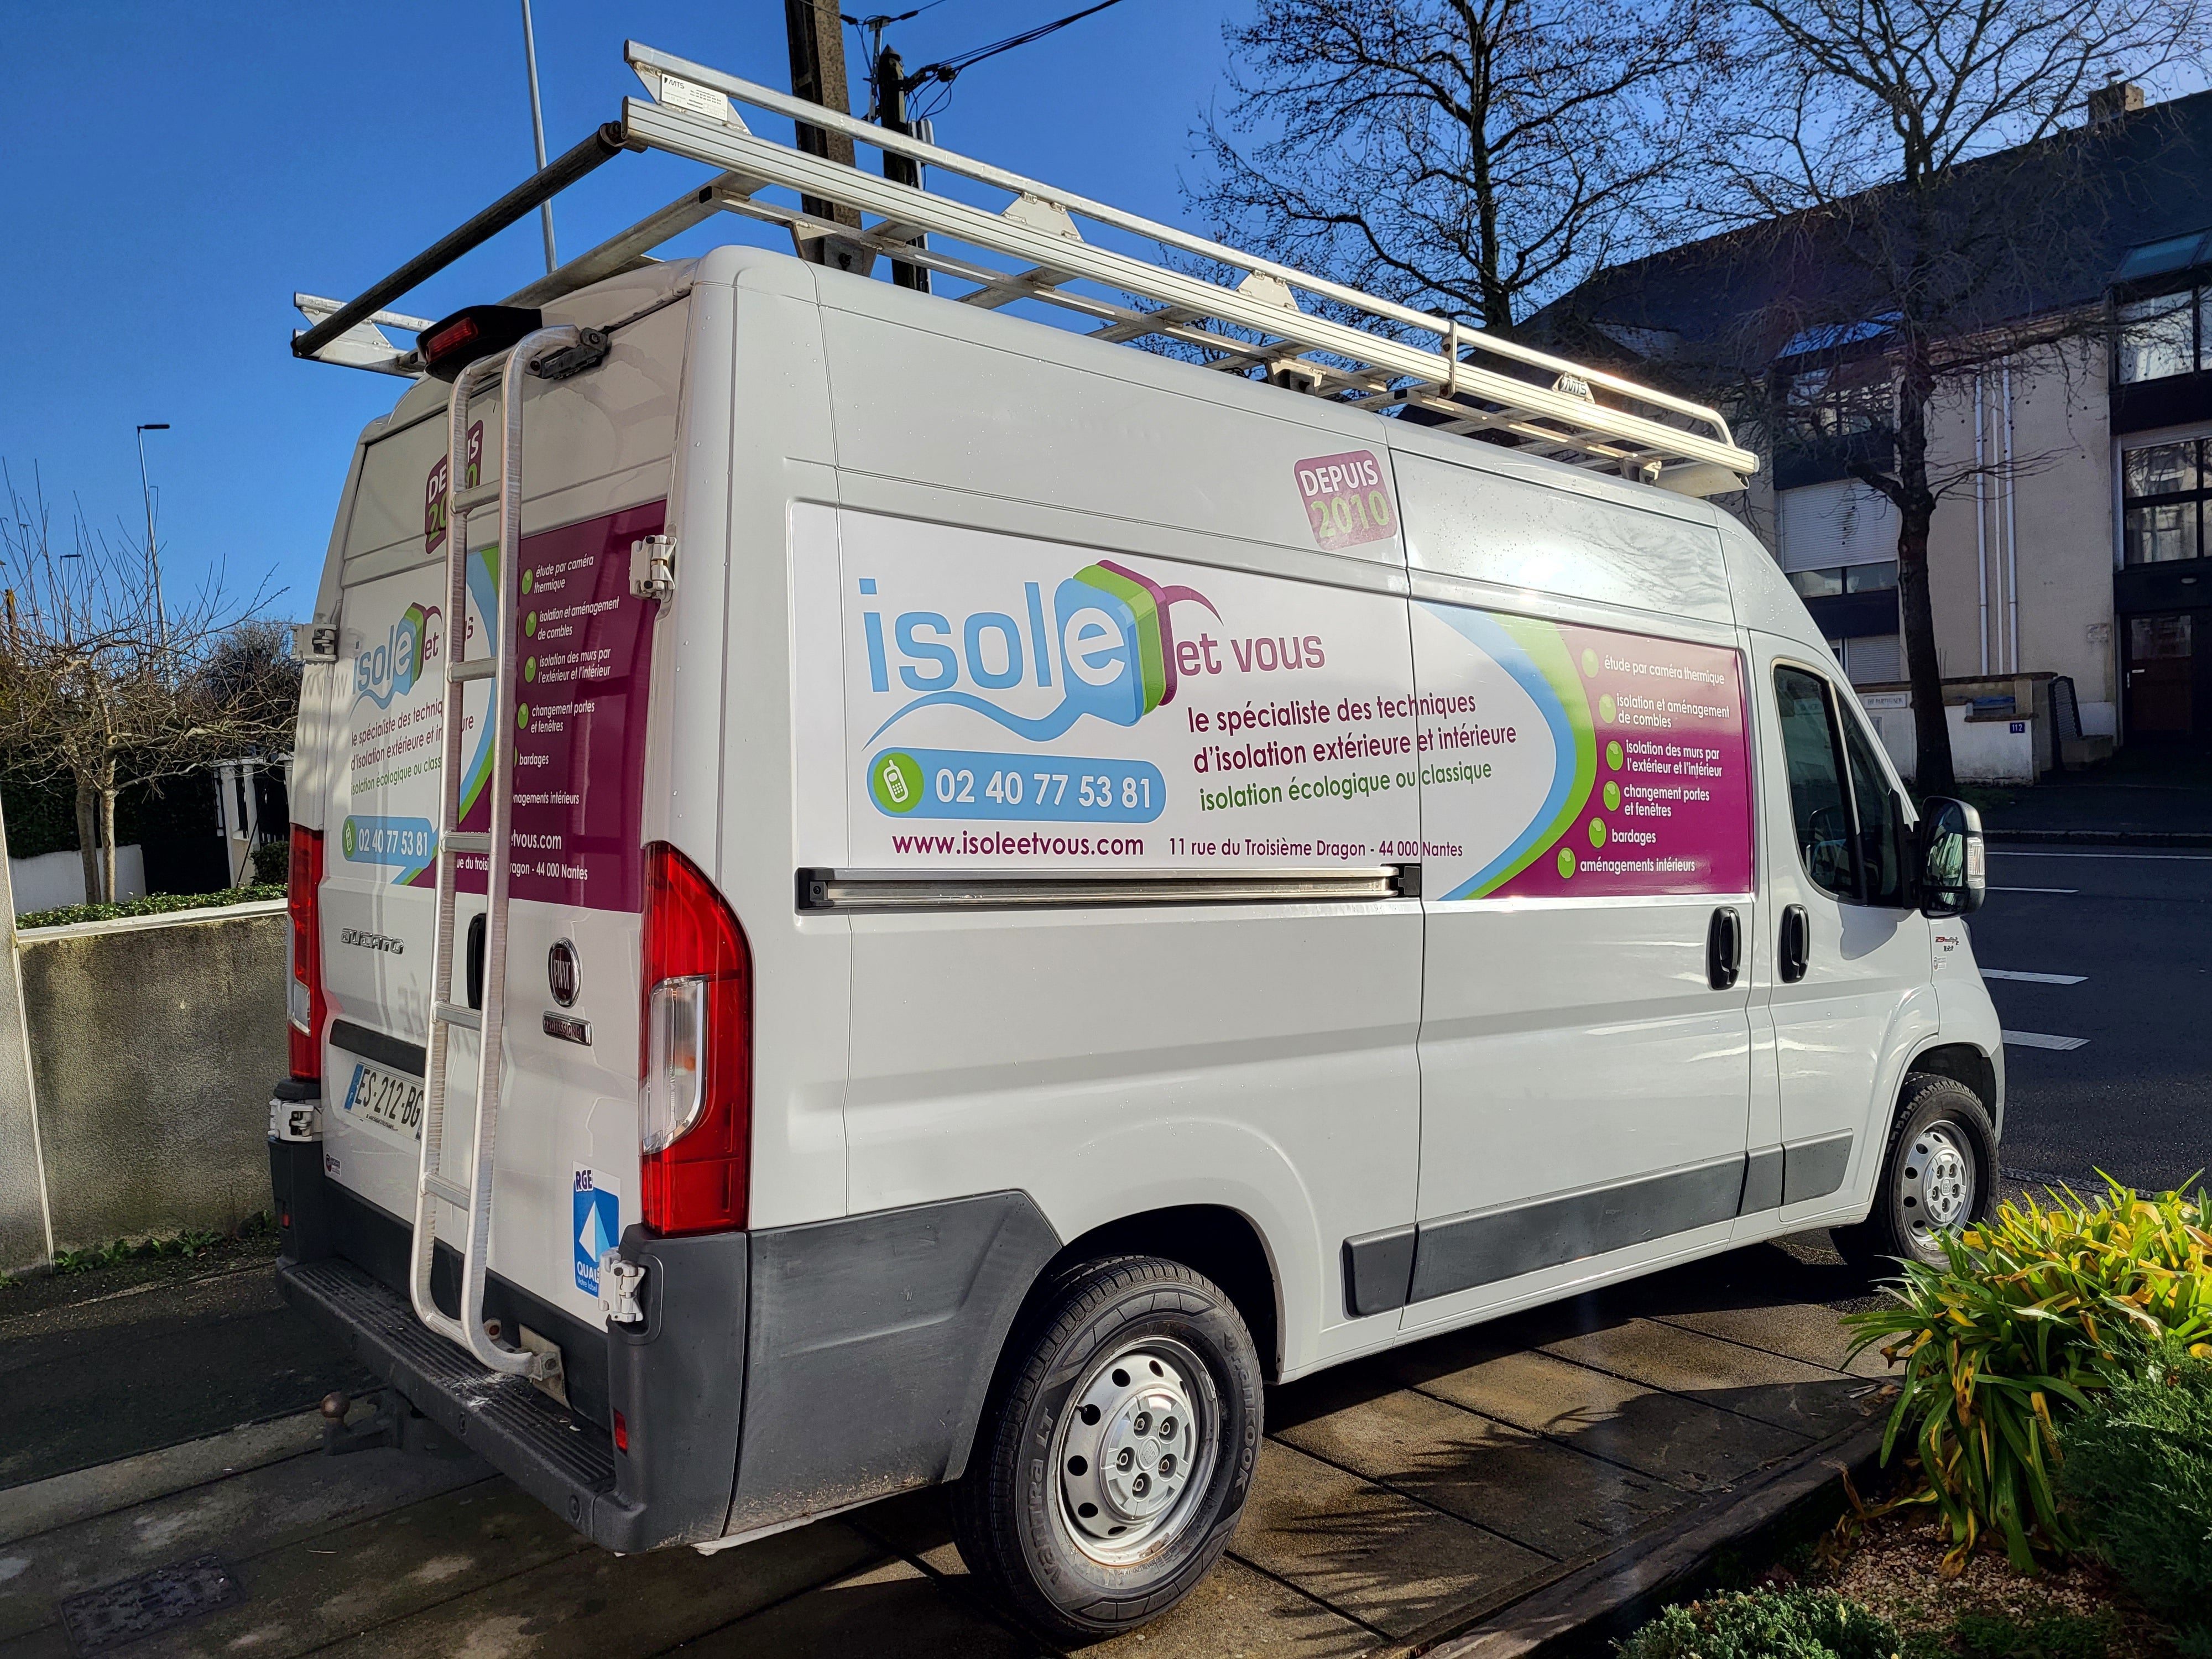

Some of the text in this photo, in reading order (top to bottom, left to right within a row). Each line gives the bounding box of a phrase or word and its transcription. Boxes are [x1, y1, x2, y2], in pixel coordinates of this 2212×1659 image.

[1299, 460, 1379, 497] DEPUIS
[1310, 490, 1390, 538] 2010
[536, 553, 594, 578] étude par caméra
[534, 578, 566, 594] thermique
[539, 596, 620, 623] isolation et aménagement
[538, 623, 573, 641] de combles
[858, 578, 1326, 692] isole et vous
[352, 624, 412, 695] isole
[424, 631, 439, 661] et
[539, 648, 611, 667] isolation des murs par
[538, 664, 611, 684] l'extérieur et l'intérieur
[1604, 655, 1725, 686] étude par caméra thermique
[531, 701, 595, 719] changement portes
[1187, 692, 1476, 736] le spécialiste des techniques
[1616, 693, 1730, 719] isolation et aménagement
[352, 697, 443, 747] le spécialiste des techniq
[531, 720, 564, 733] et fenêtres
[1618, 711, 1672, 728] de combles
[2012, 723, 2022, 732] 112
[351, 743, 385, 771] d'isolation
[387, 735, 424, 759] extérieure
[426, 726, 434, 745] et
[1193, 723, 1517, 773] d'isolation extérieure et intérieure
[1626, 739, 1720, 761] isolation des murs par
[519, 753, 549, 768] bardages
[1626, 757, 1723, 778] l'extérieur et l'intérieur
[351, 774, 375, 796] isolation
[376, 766, 412, 787] écologique
[413, 763, 422, 775] ou
[936, 769, 1151, 808] 02 40 77 53 81
[1200, 761, 1492, 811] isolation écologique ou classique
[550, 791, 580, 805] intérieurs
[1624, 784, 1710, 802] changement portes
[1624, 803, 1672, 817] et fenêtres
[358, 828, 428, 857] 02 40 77 53 81
[891, 831, 1144, 855] www.isoleetvous.com
[1168, 837, 1185, 855] 11
[1191, 841, 1217, 856] rue
[1220, 837, 1240, 856] du
[1244, 837, 1312, 857] Troisième
[1317, 839, 1366, 860] Dragon
[1379, 840, 1394, 856] 44
[1396, 841, 1419, 856] 000
[1422, 841, 1463, 857] Nantes
[1612, 828, 1656, 846] bardages
[465, 856, 474, 869] du
[536, 861, 546, 877] 44
[546, 863, 560, 878] 000
[561, 864, 588, 880] Nantes
[1580, 856, 1695, 875] aménagements intérieurs
[340, 927, 404, 955] DUCATO
[554, 959, 571, 990] FIAT
[575, 1170, 593, 1190] RGE
